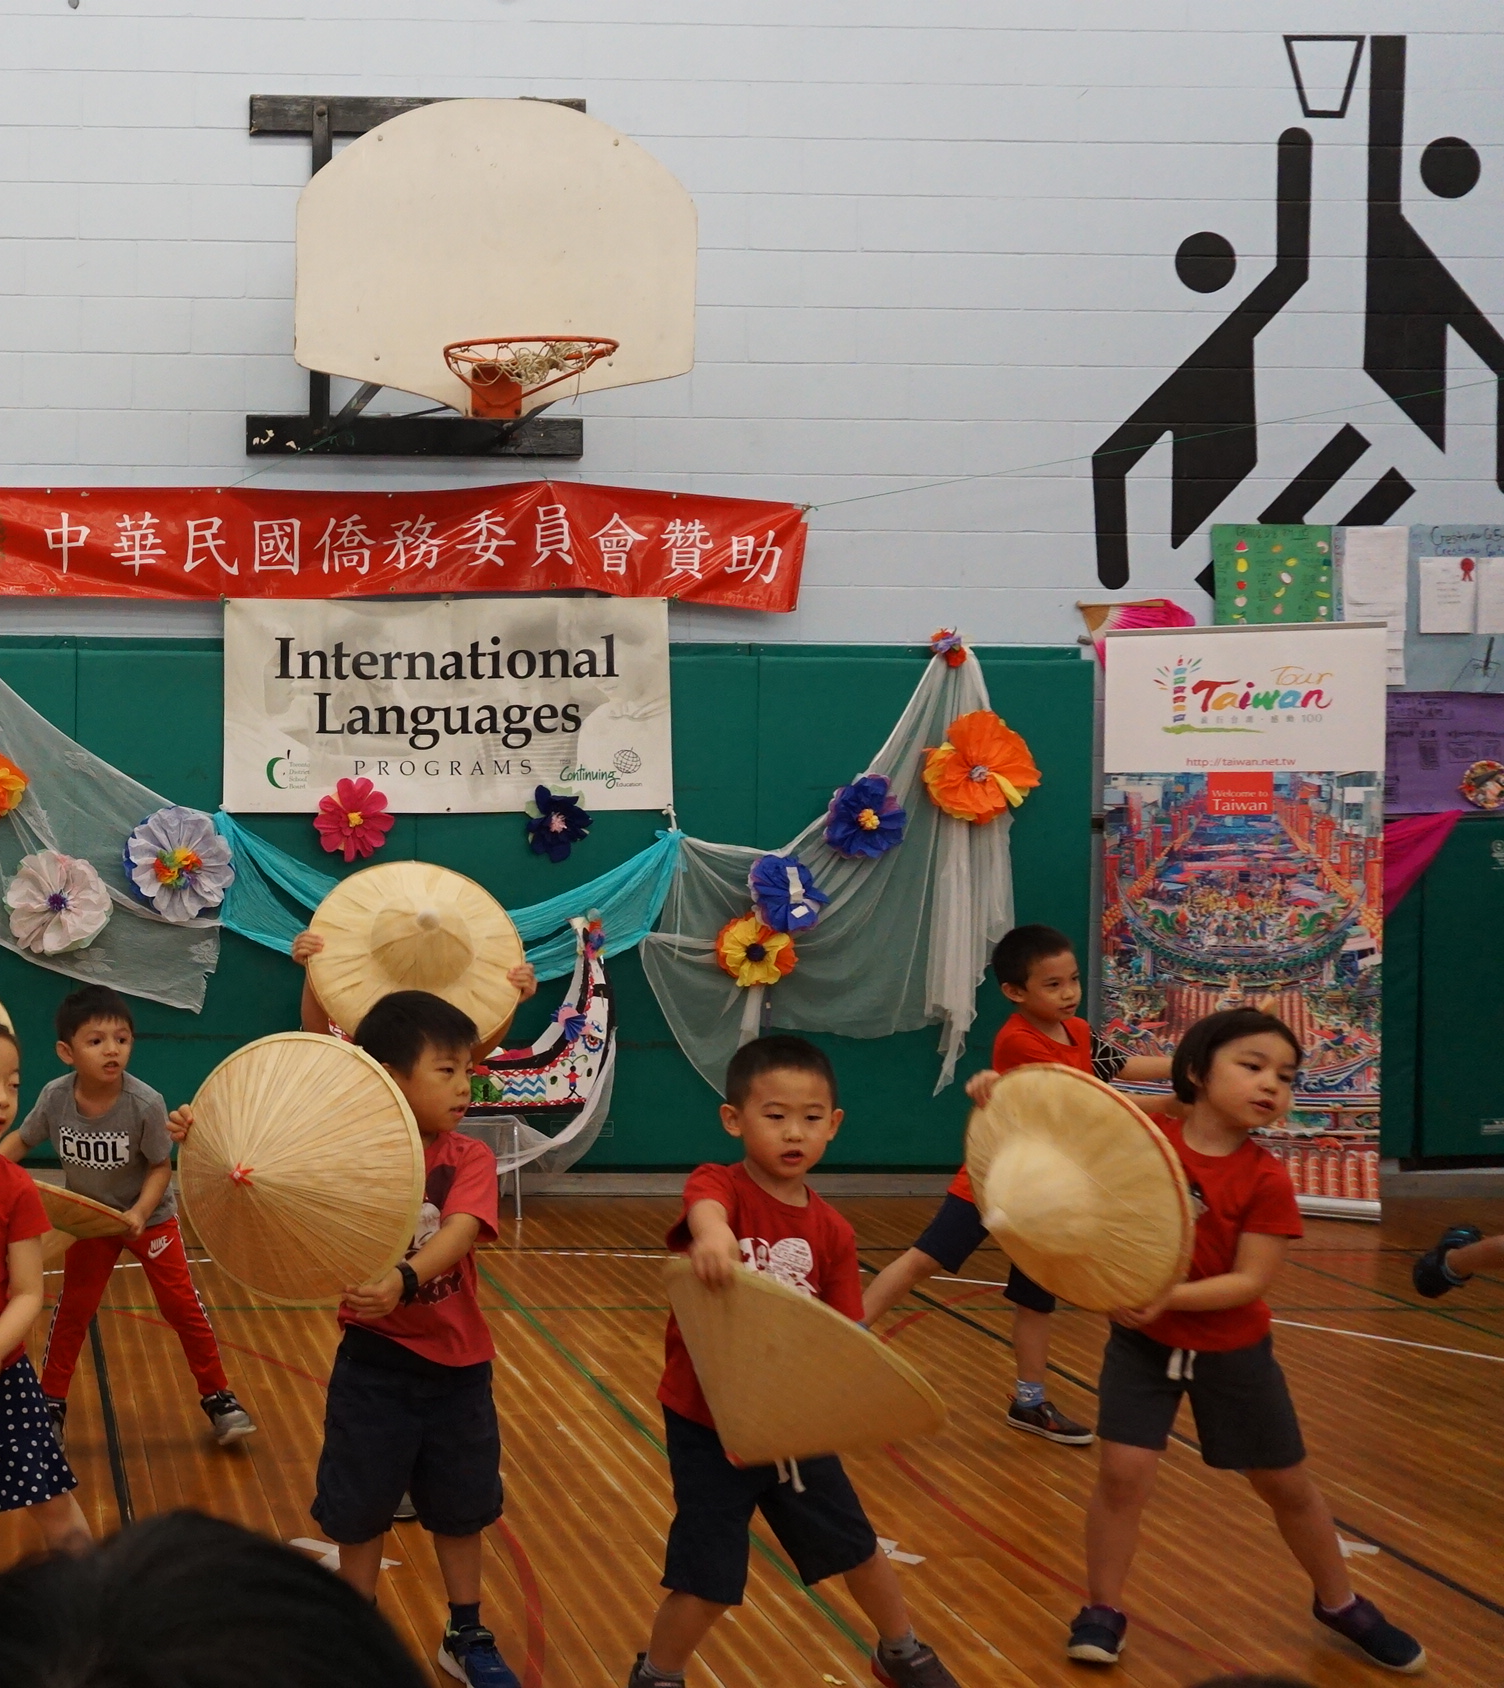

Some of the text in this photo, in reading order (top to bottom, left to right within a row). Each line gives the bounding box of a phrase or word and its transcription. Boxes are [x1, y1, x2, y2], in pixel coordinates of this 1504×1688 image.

[44, 502, 783, 585] 中華民國僑務委員會贊助
[274, 633, 620, 682] International
[1270, 665, 1334, 686] Tour
[1191, 678, 1334, 713] Taiwan
[314, 691, 583, 751] Languages
[353, 759, 533, 778] PROGRAMS
[1186, 757, 1297, 768] http://taiwan.net.tw
[559, 763, 621, 790] Continuing
[1211, 790, 1269, 799] Welcome to
[1212, 799, 1269, 812] Taiwan
[62, 1135, 125, 1163] COOL
[149, 1234, 169, 1251] NIKE
